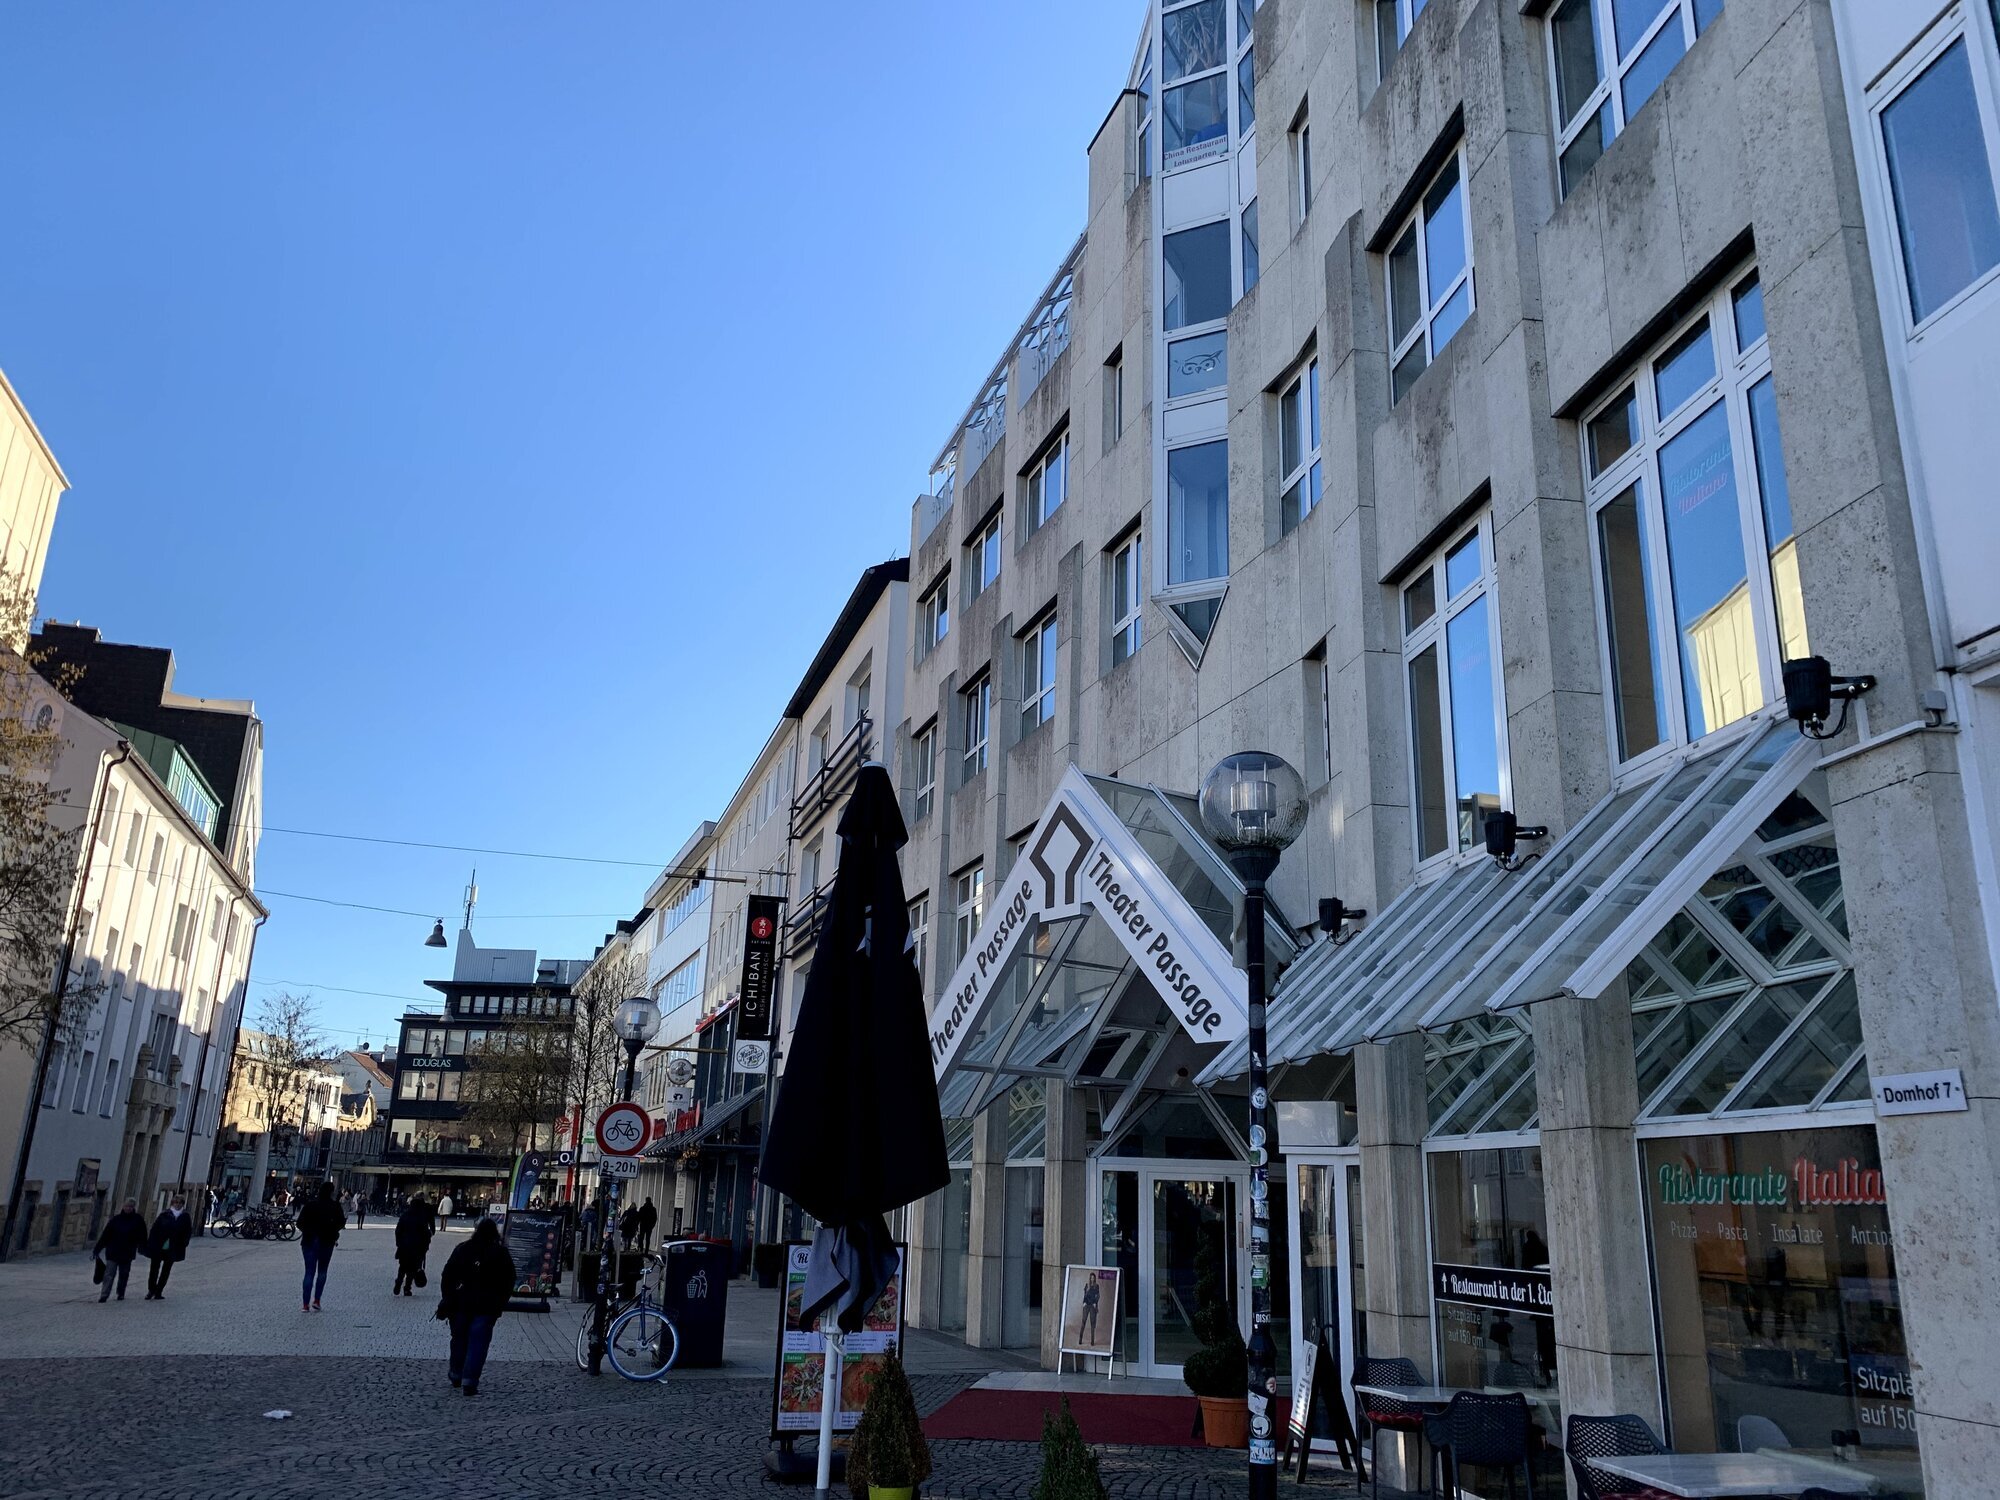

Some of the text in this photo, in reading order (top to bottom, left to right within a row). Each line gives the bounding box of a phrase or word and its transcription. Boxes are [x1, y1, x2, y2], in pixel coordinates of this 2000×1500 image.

[1163, 136, 1227, 161] China Restaurant
[1089, 851, 1222, 1037] Theater Passage
[745, 951, 761, 1018] ICHIBAN
[930, 879, 1033, 1066] Theater Passage
[412, 1058, 452, 1068] DOUGLAS
[1883, 1082, 1951, 1103] Domhof 7
[1658, 1163, 1787, 1206] Ristorante
[1670, 1221, 1698, 1240] Pizza
[1718, 1222, 1749, 1241] Pasta
[1771, 1223, 1824, 1245] Insalate
[1450, 1274, 1498, 1299] Restaurant
[1498, 1280, 1509, 1300] in
[1510, 1282, 1526, 1302] der
[1527, 1283, 1536, 1303] 1.
[1861, 1404, 1918, 1432] auf 150
